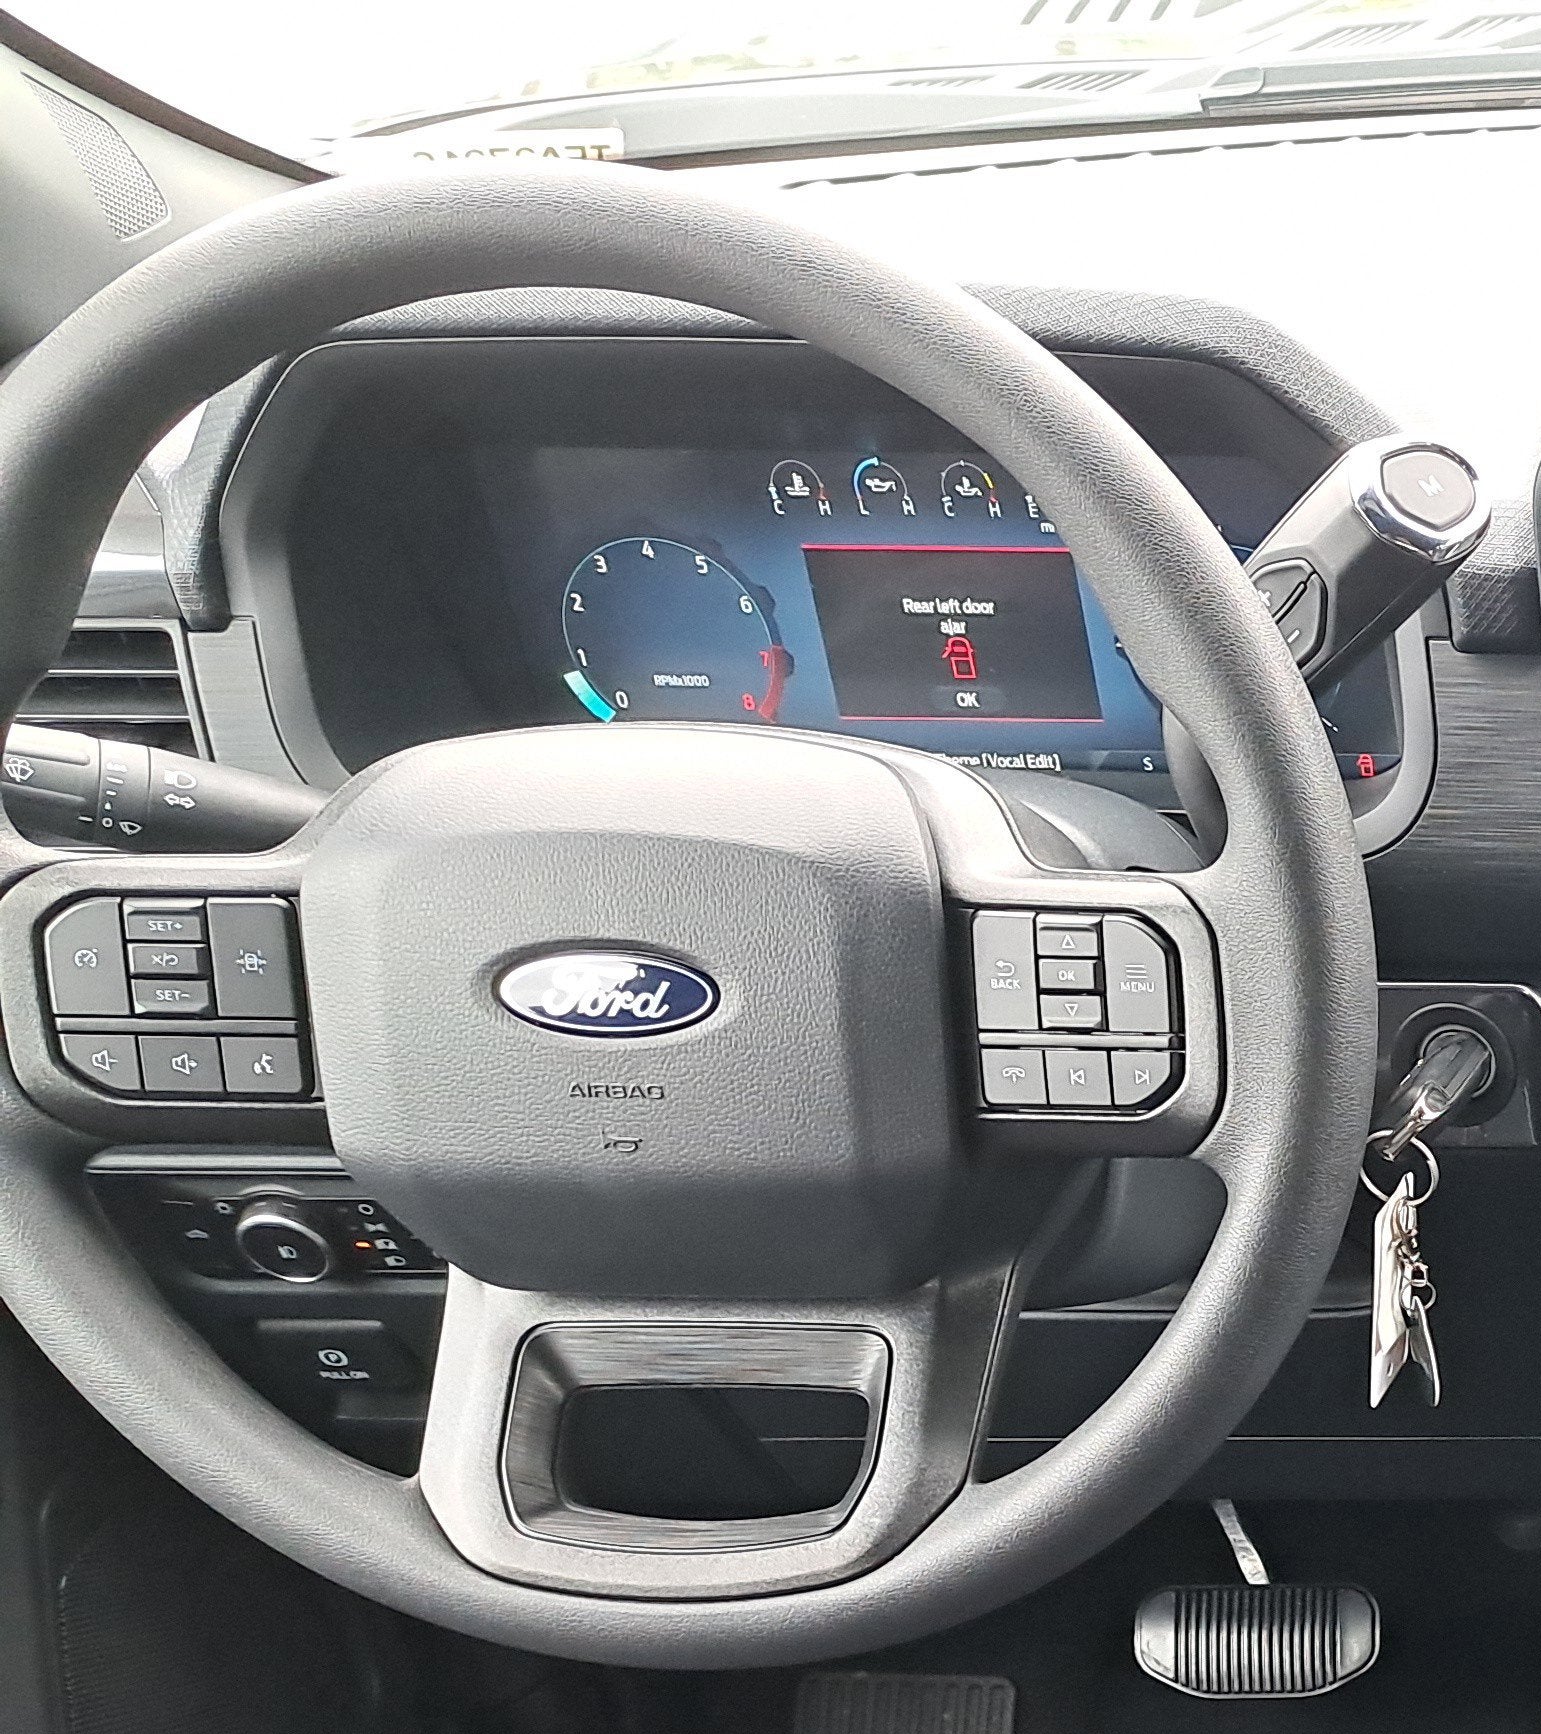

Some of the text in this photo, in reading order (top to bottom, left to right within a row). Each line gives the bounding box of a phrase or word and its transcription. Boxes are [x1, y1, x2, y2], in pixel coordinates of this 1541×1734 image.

[1418, 475, 1445, 497] M
[773, 500, 785, 516] C
[819, 501, 832, 517] H
[858, 500, 870, 516] L
[902, 500, 916, 516] H
[944, 501, 955, 517] C
[989, 502, 1001, 518] H
[1028, 503, 1039, 518] E
[641, 540, 656, 560] 4
[593, 555, 608, 574] 3
[694, 555, 709, 574] 5
[570, 592, 586, 613] 2
[739, 595, 753, 614] 6
[902, 598, 995, 616] Rear left door
[940, 618, 966, 636] ajar
[577, 648, 588, 667] 1
[615, 690, 629, 709] 0
[742, 693, 756, 711] 8
[956, 692, 980, 709] OK
[1142, 757, 1154, 771] S
[990, 978, 1022, 990] BACK
[1058, 970, 1076, 981] OK
[540, 962, 672, 1019] Ford
[1120, 981, 1155, 993] MENU
[569, 1082, 665, 1100] AIRBAG
